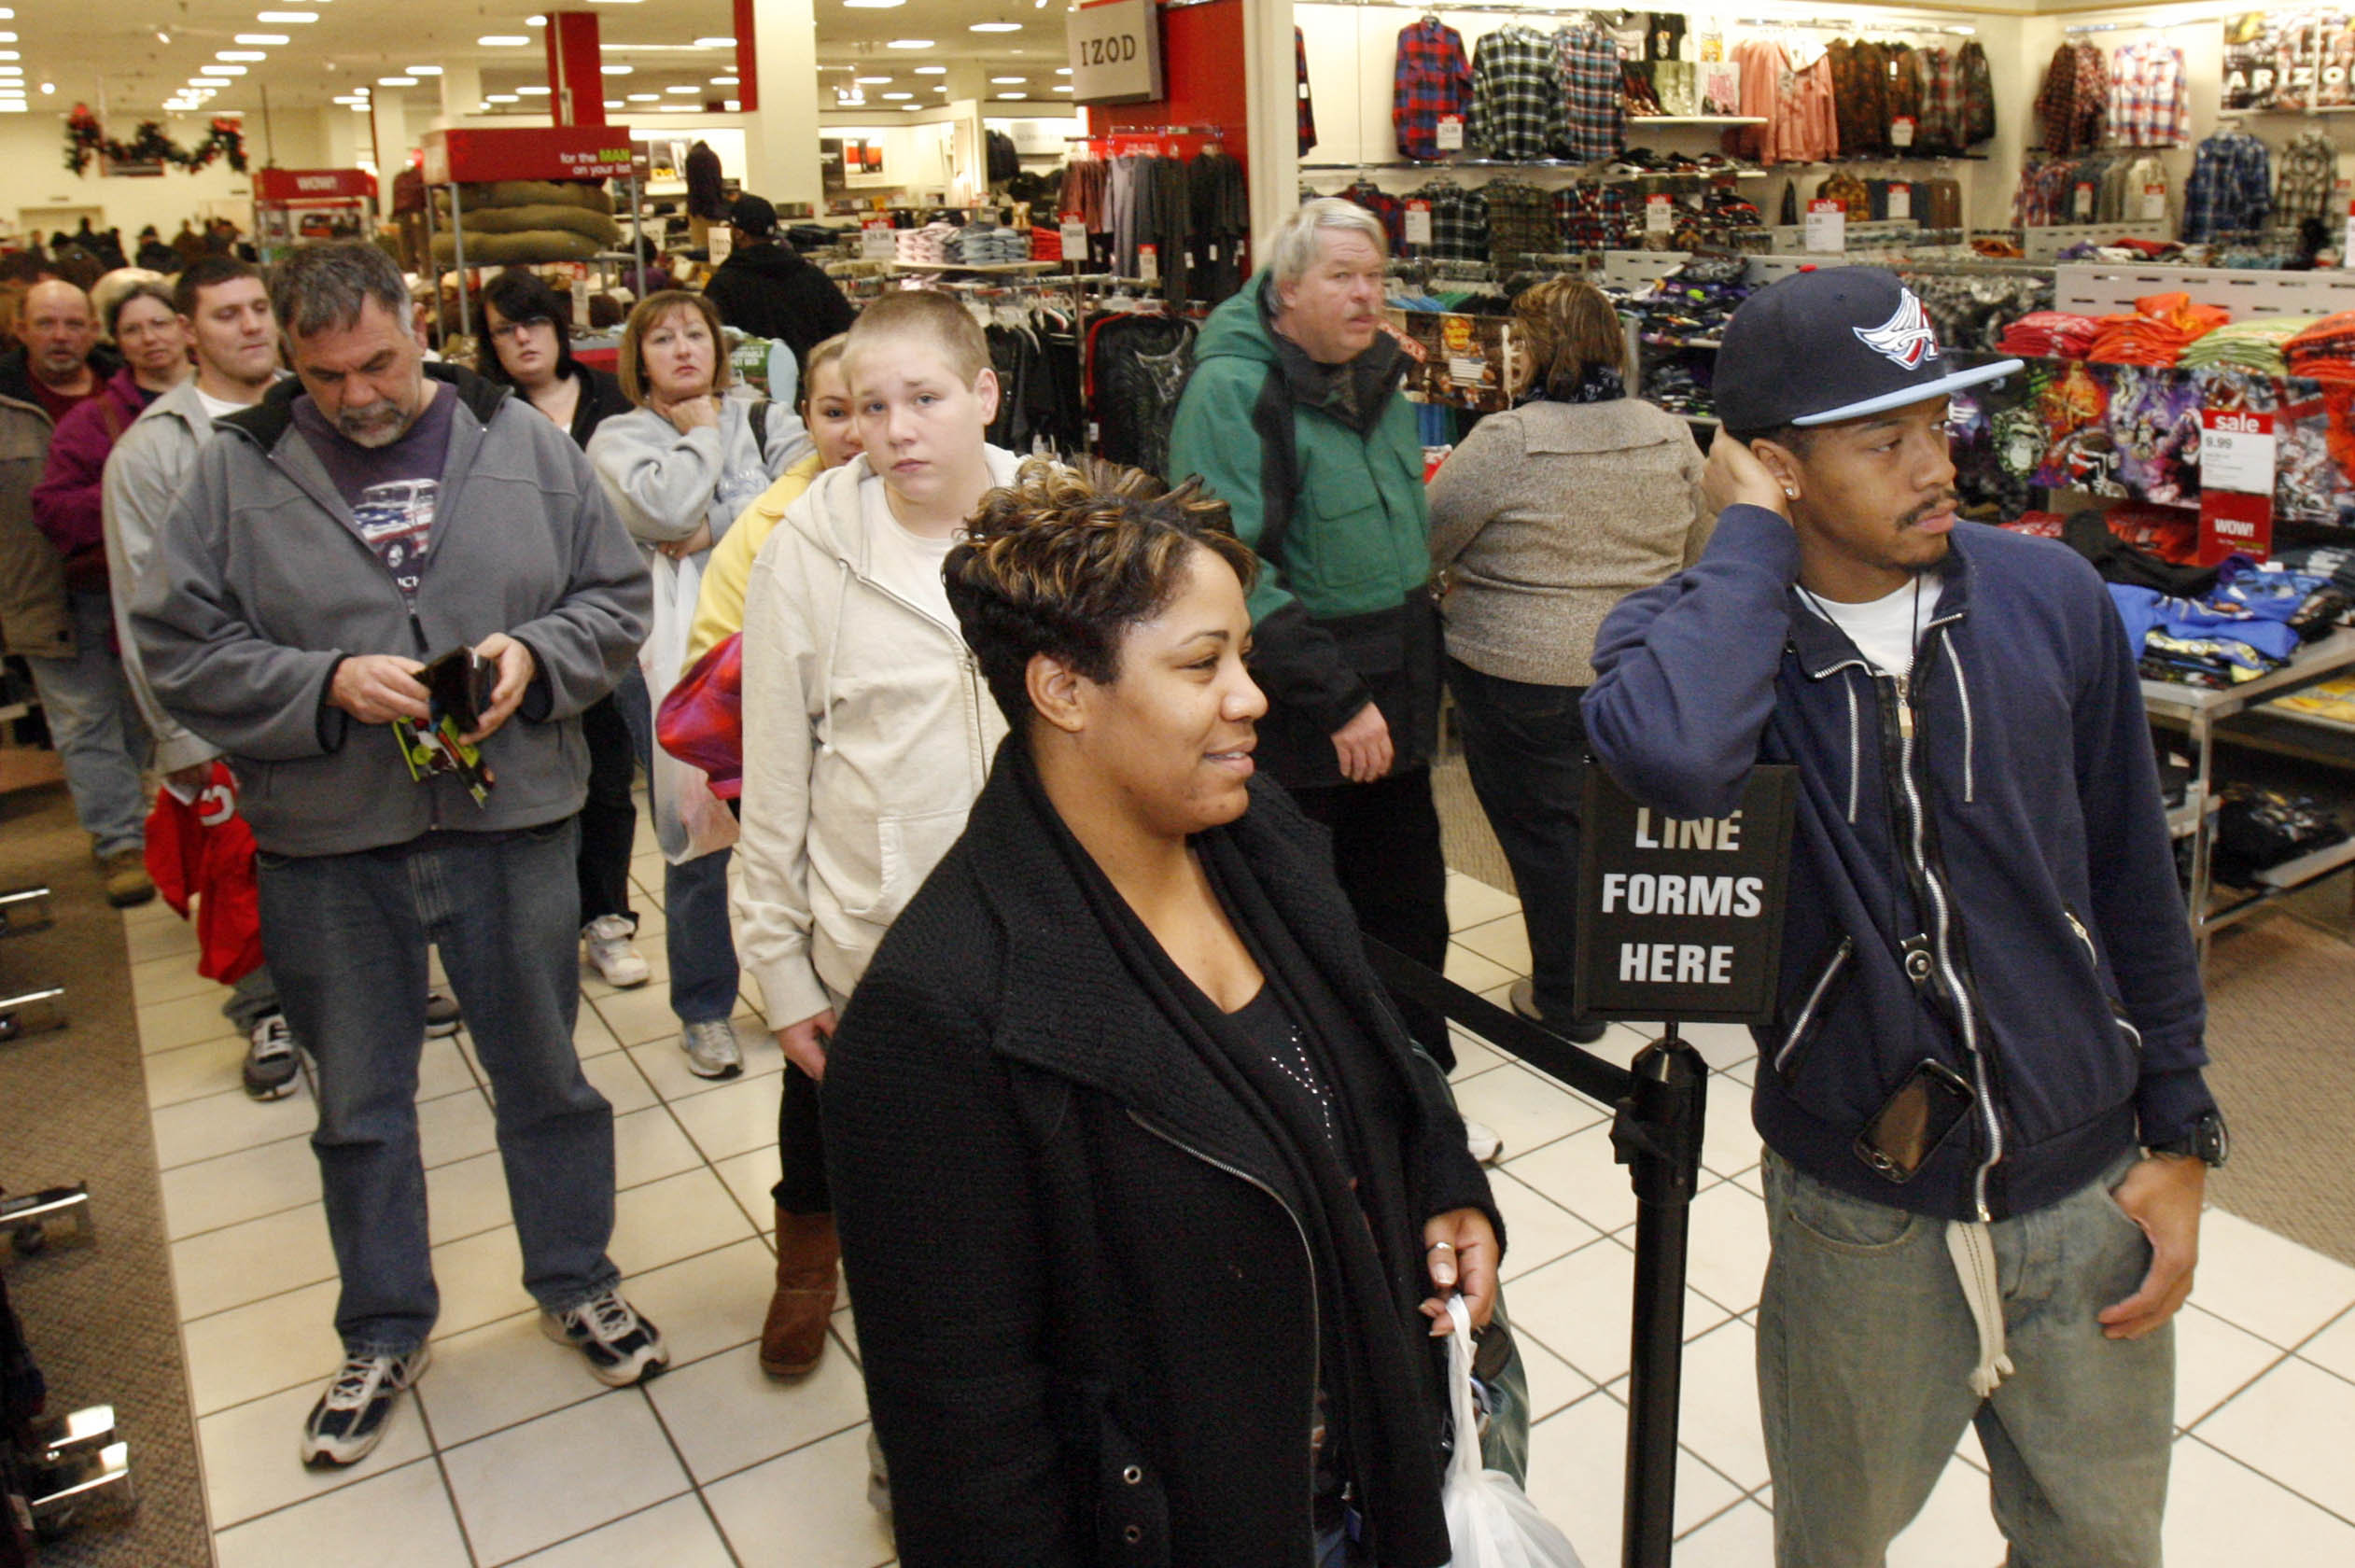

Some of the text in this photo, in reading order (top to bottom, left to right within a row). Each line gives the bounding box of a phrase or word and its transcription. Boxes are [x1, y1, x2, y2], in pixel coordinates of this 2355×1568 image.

[1081, 34, 1136, 66] IZOD
[2228, 65, 2355, 90] ARIZO
[560, 148, 631, 163] for the MAN
[590, 165, 614, 177] your
[2215, 413, 2259, 433] sale
[2215, 519, 2254, 538] WOW!
[1635, 807, 1743, 850] LINE
[1602, 874, 1763, 917] FORMS
[1619, 943, 1733, 984] HERE
